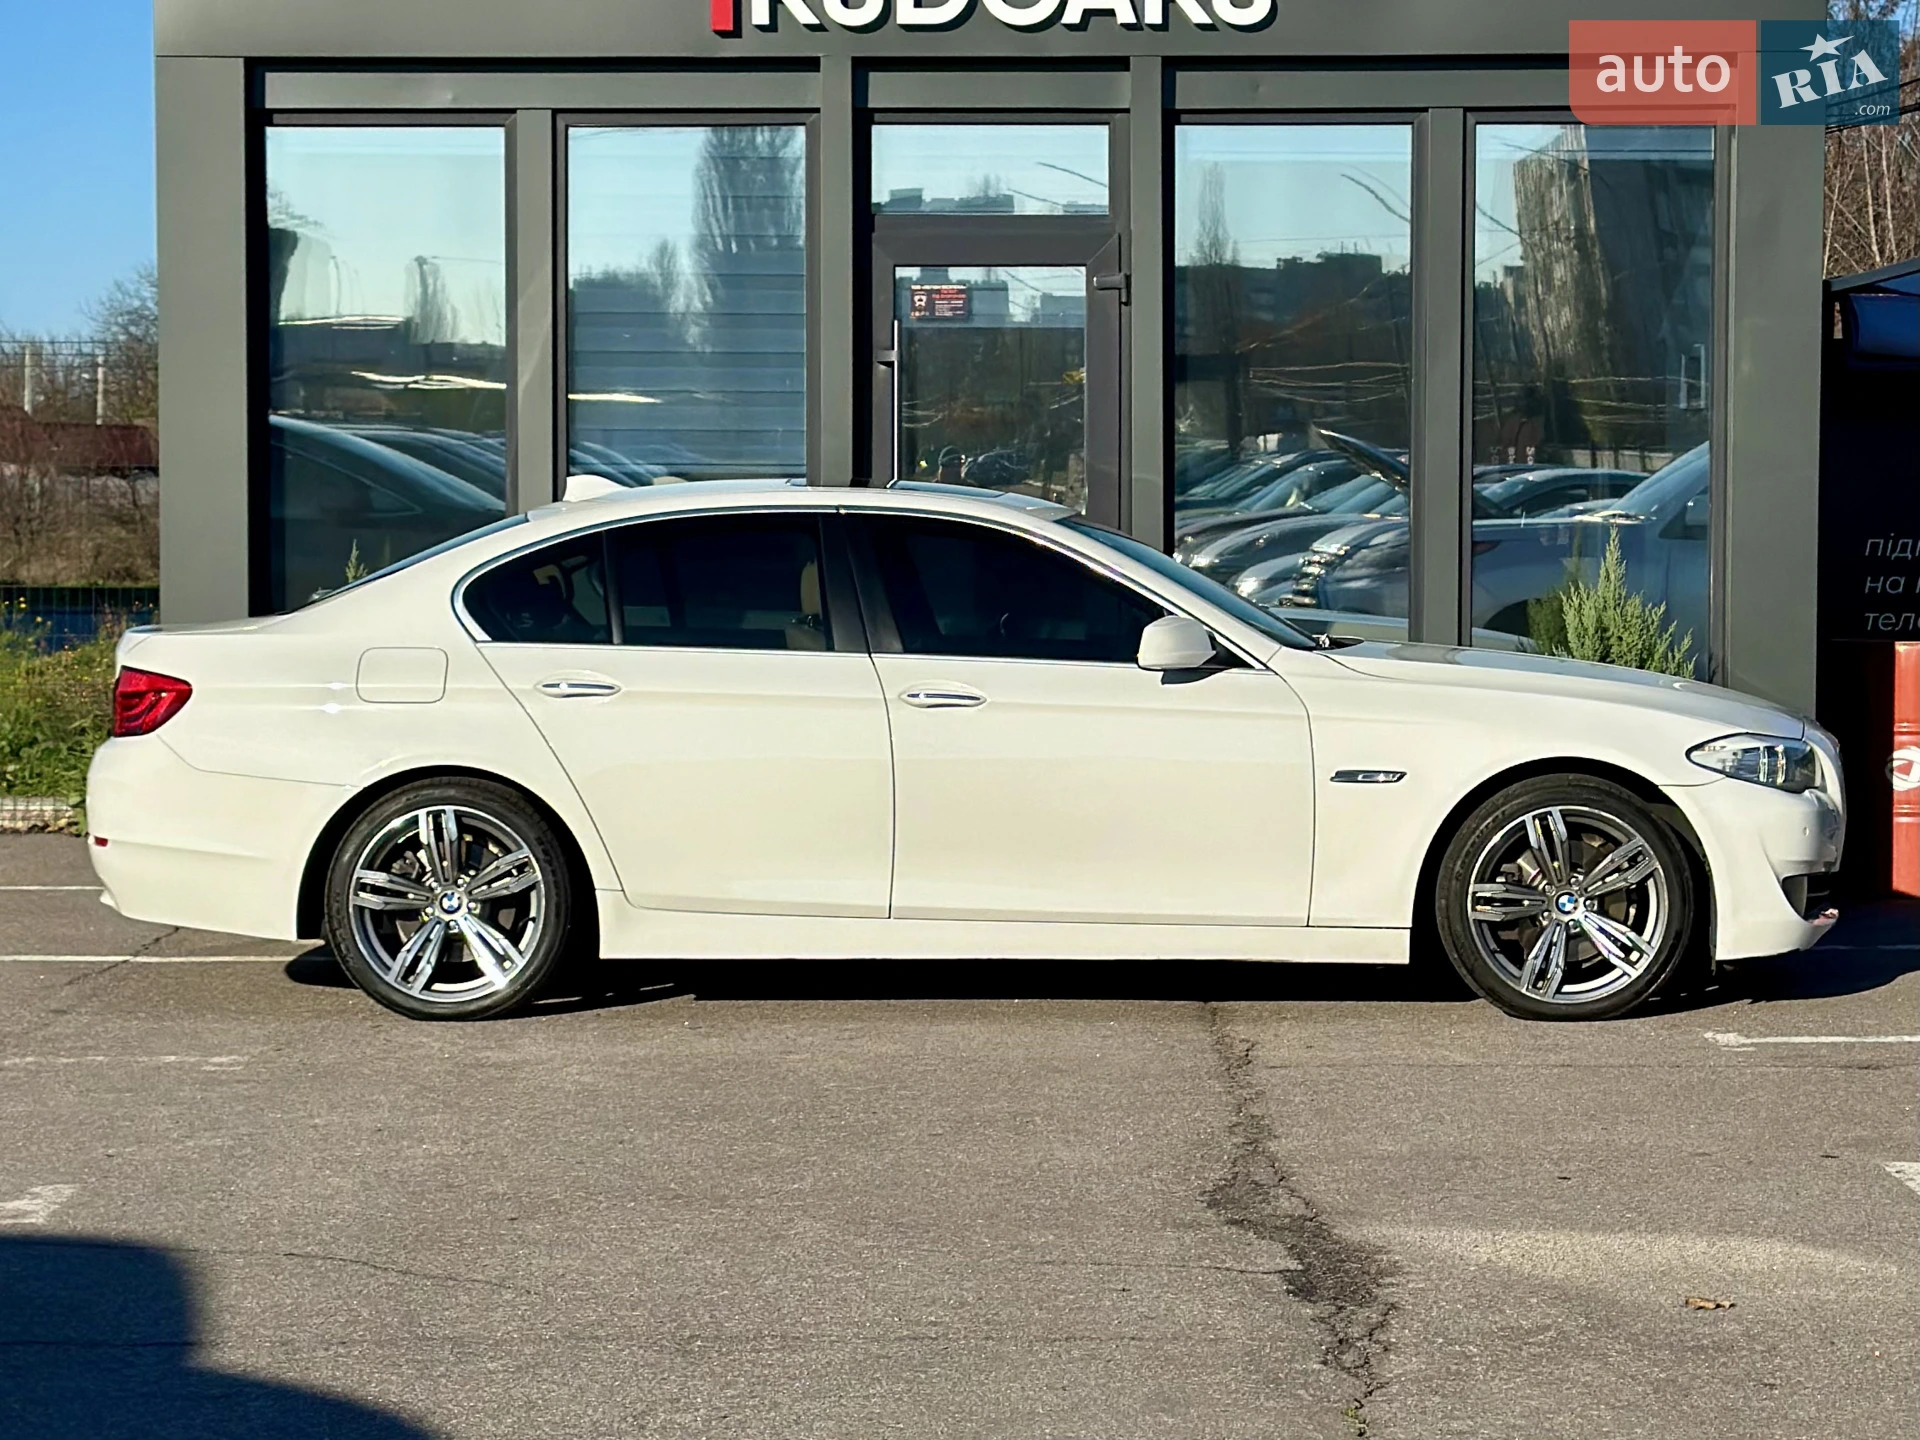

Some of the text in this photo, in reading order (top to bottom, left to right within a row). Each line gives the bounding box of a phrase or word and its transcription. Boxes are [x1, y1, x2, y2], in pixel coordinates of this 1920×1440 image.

[1864, 532, 1920, 561] під
[1864, 576, 1906, 594] на
[1864, 612, 1920, 631] тел
